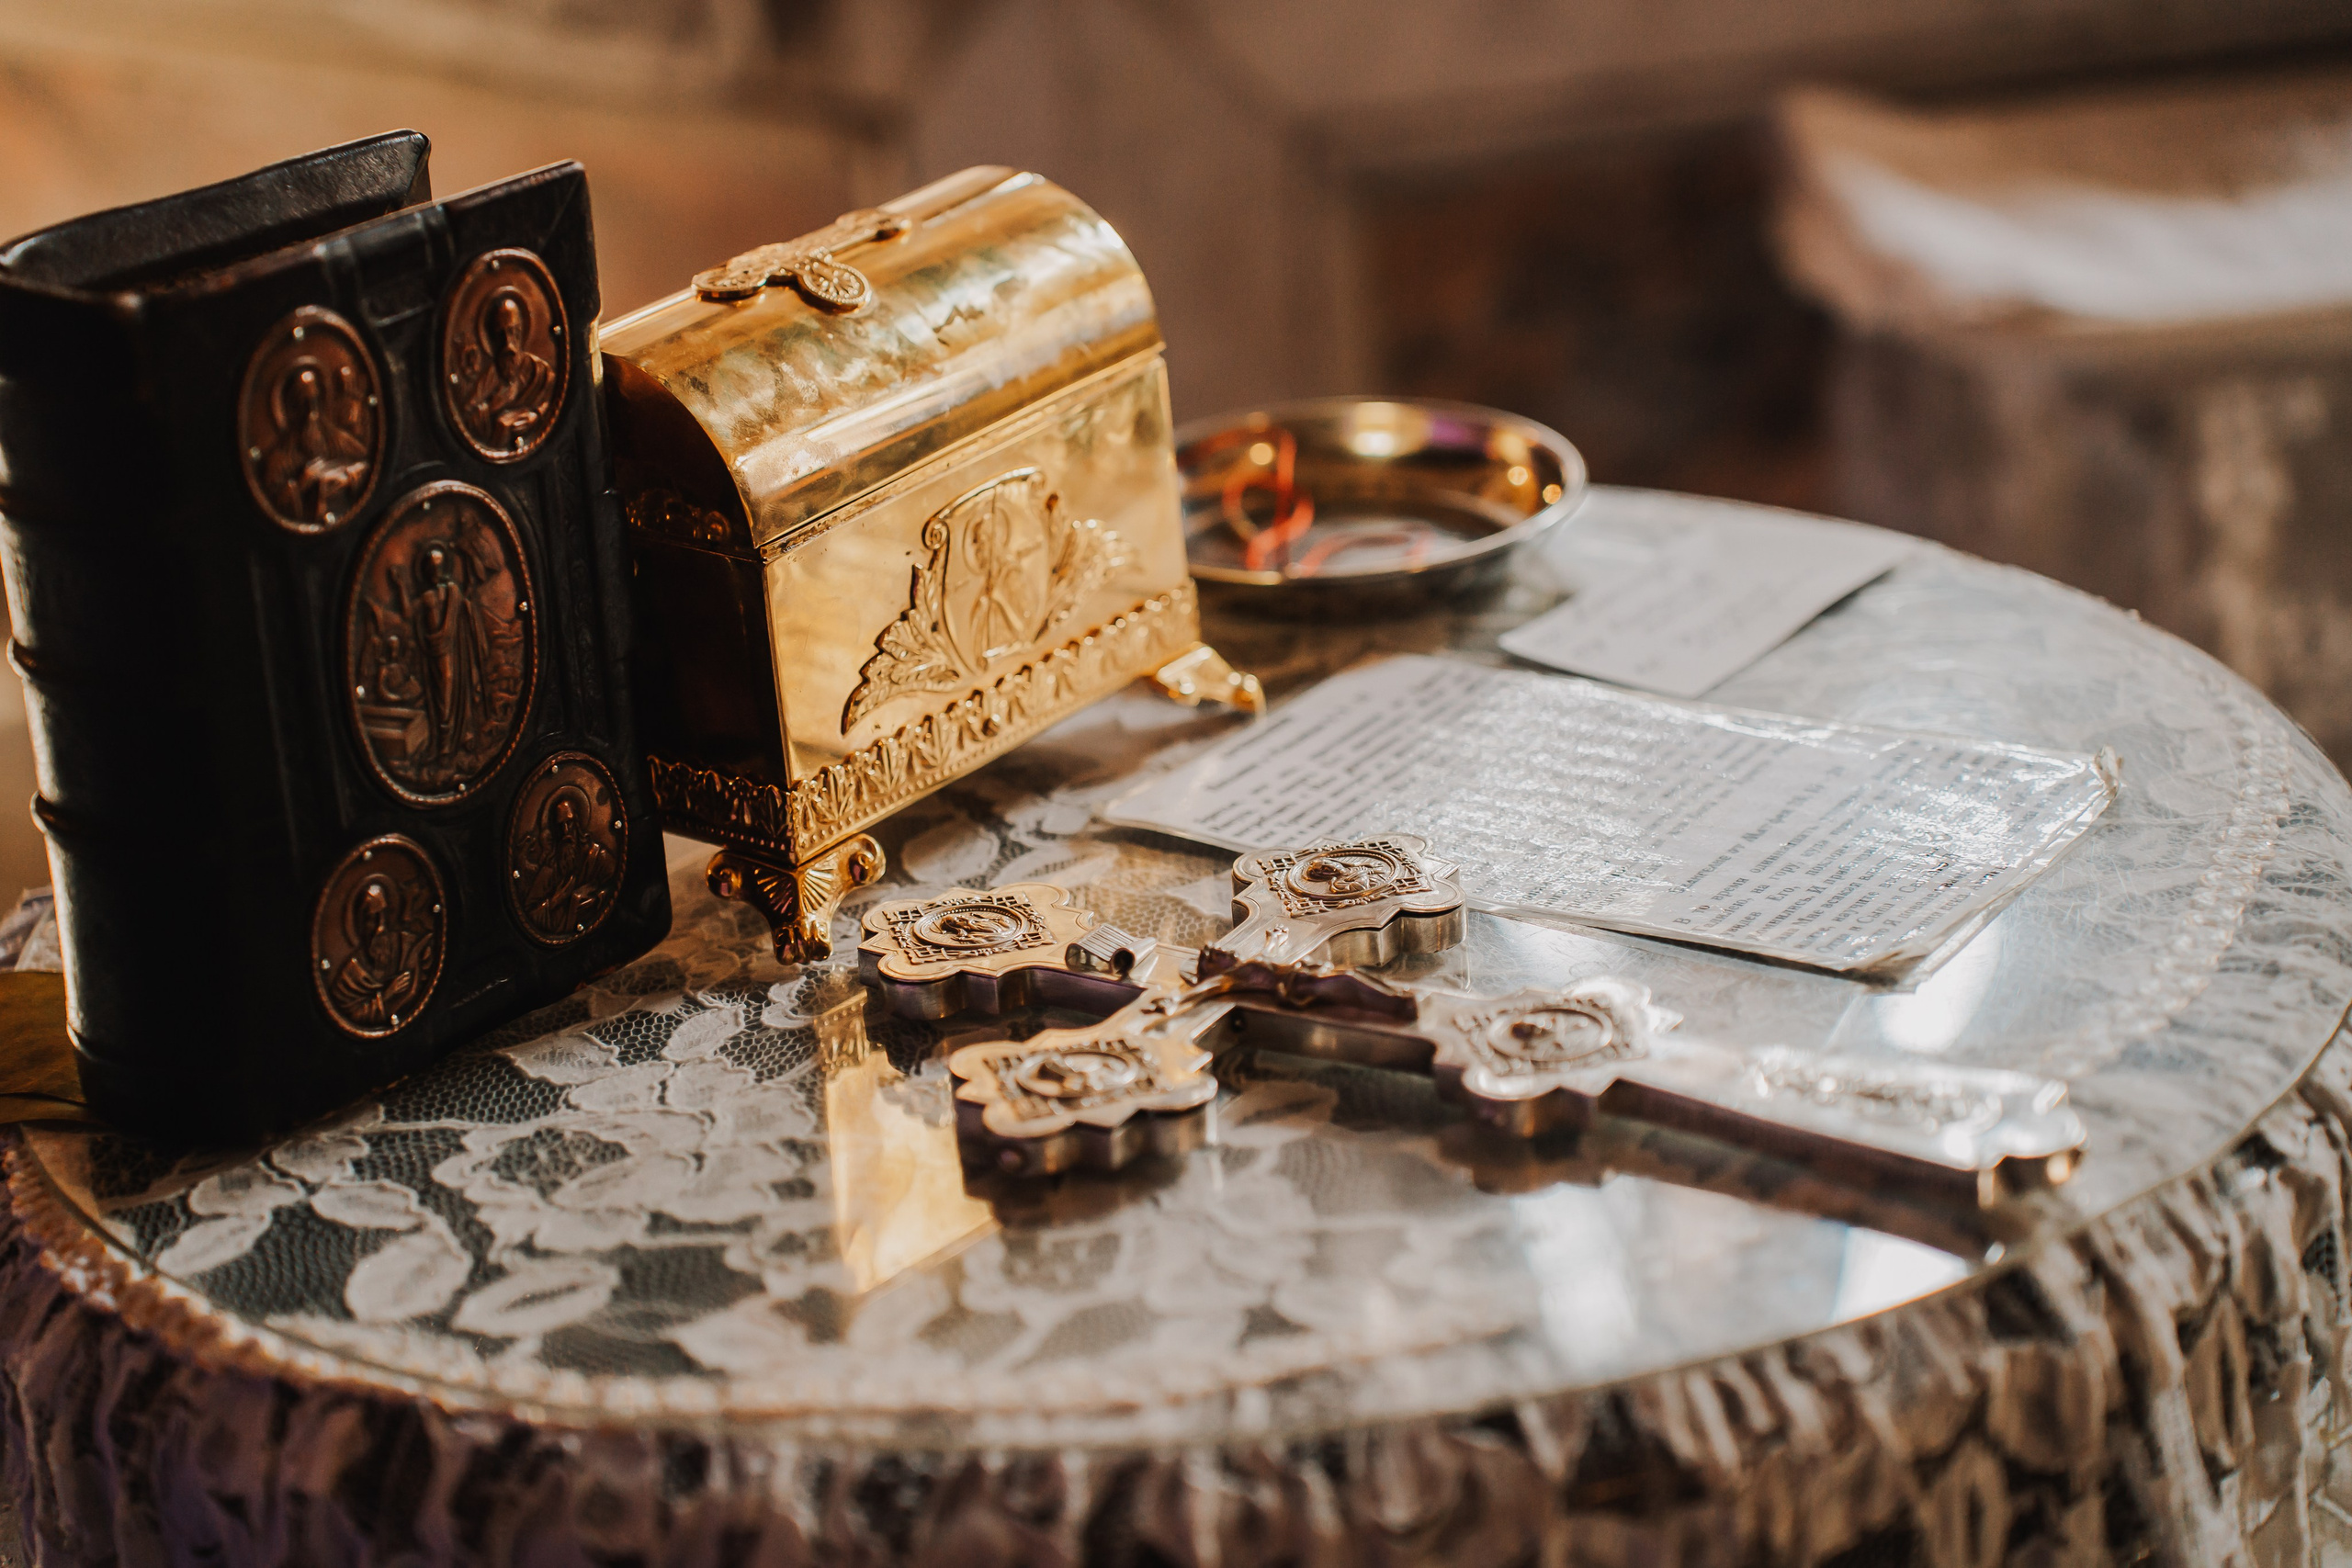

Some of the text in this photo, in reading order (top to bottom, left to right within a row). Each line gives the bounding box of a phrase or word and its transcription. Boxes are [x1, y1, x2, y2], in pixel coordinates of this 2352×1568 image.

[1727, 843, 1745, 853] от
[1691, 897, 1753, 931] Галилею,
[1750, 885, 1770, 894] на
[1770, 863, 1804, 880] гору,
[1711, 878, 1749, 900] время
[1792, 910, 1824, 925] Мне
[1821, 882, 1862, 908] всякая
[1832, 892, 1879, 922] научите
[1724, 912, 1761, 934] увидев
[1766, 886, 1801, 901] Его,
[1748, 897, 1815, 941] уомнились.
[1806, 886, 1826, 894] И
[1856, 903, 1894, 923] Сына
